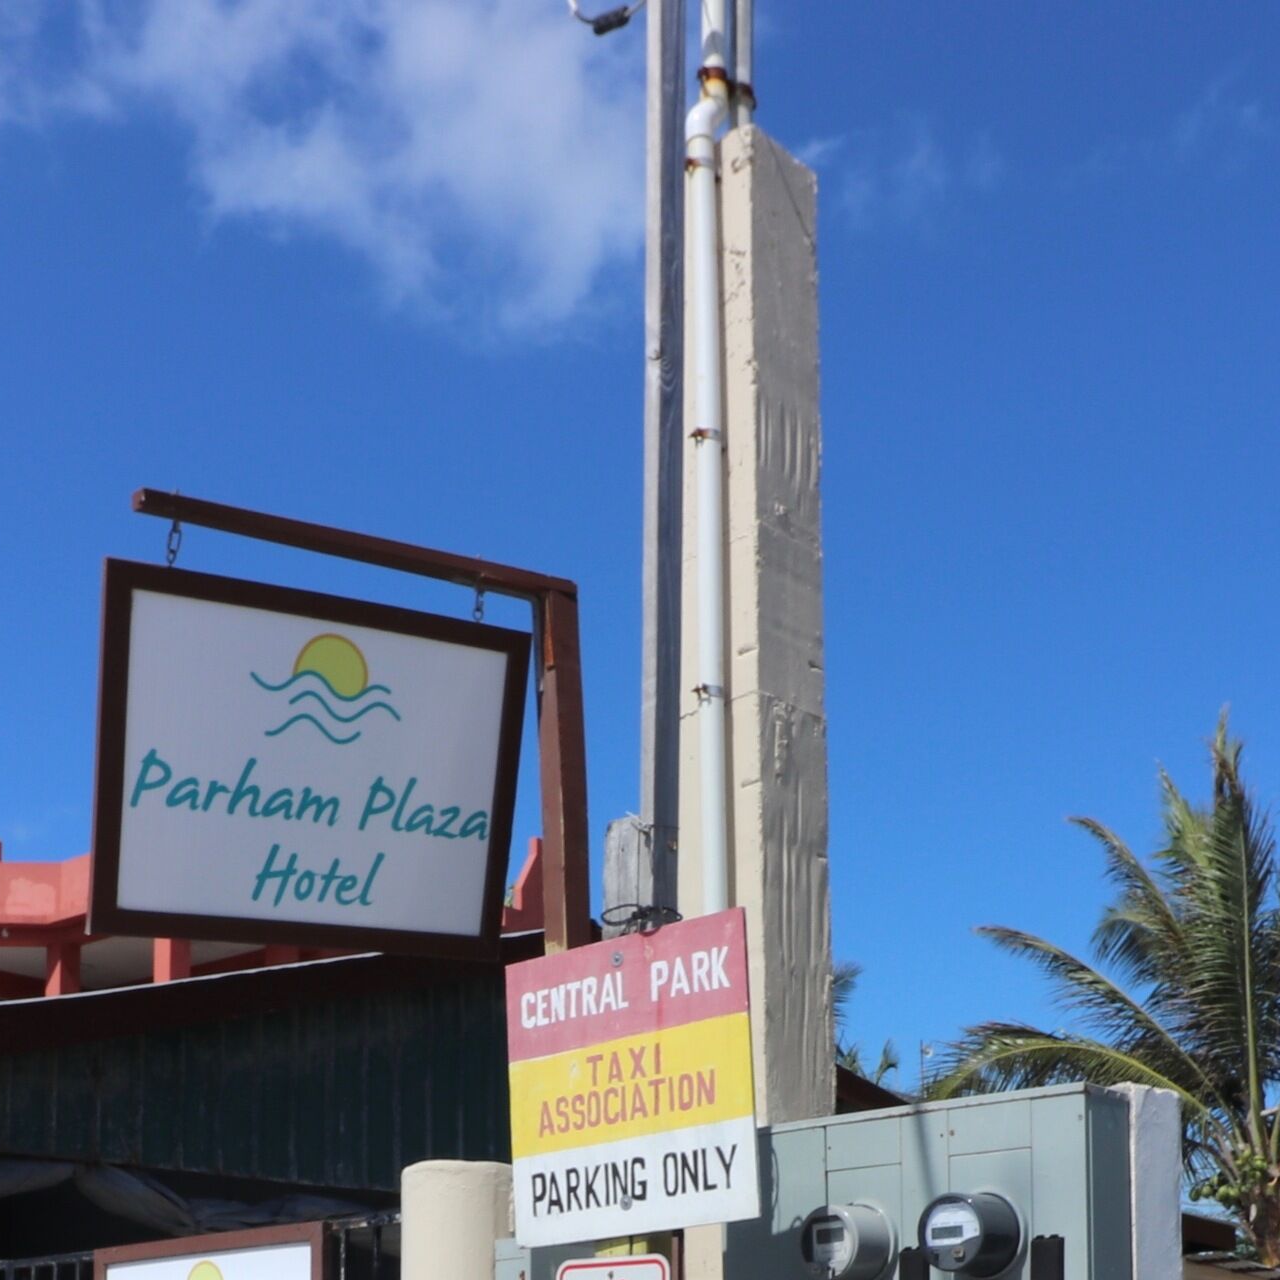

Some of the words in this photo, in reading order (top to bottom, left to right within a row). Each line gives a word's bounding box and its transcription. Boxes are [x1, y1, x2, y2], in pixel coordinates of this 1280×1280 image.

[129, 748, 341, 828] Parham
[357, 774, 490, 842] Plaza
[251, 843, 385, 908] Hotel
[520, 970, 629, 1029] CENTRAL
[650, 945, 731, 1002] PARK
[586, 1042, 662, 1087] TAXI
[538, 1069, 716, 1137] ASSOCIATION
[531, 1156, 648, 1217] PARKING
[662, 1144, 738, 1198] ONLY
